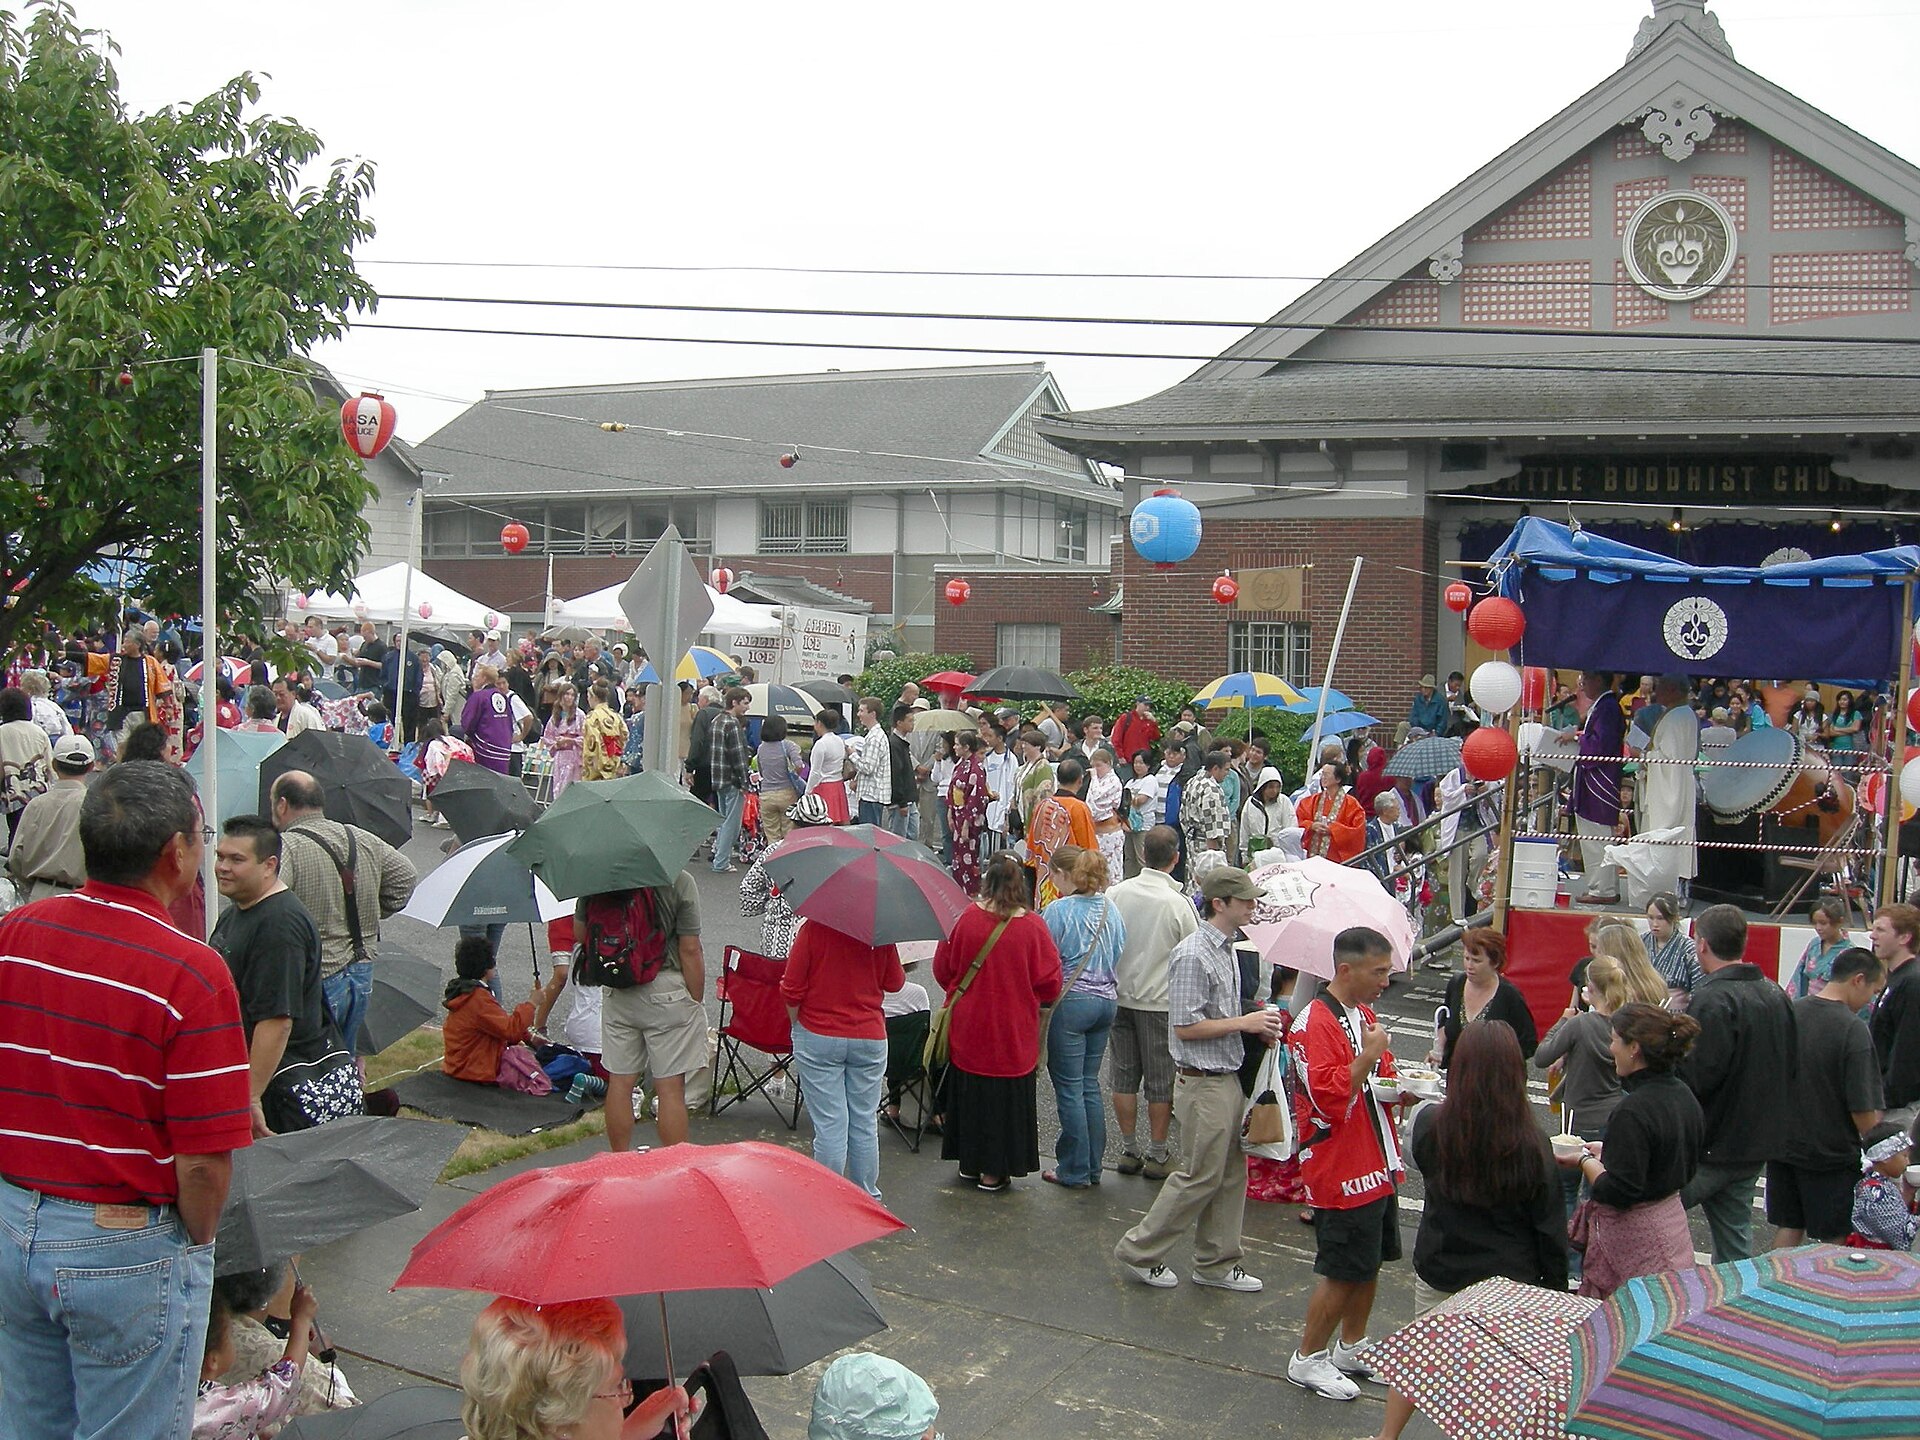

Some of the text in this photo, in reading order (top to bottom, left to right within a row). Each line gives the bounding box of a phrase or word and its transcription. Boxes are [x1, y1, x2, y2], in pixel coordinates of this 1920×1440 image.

[1474, 467, 1582, 491] ATTLE
[1604, 466, 1754, 491] BUDDHIST
[804, 618, 842, 637] ALLIED
[734, 635, 794, 649] ALLIED
[803, 635, 821, 651] ICE
[749, 650, 776, 664] ICE
[1341, 1168, 1390, 1197] KIRIN
